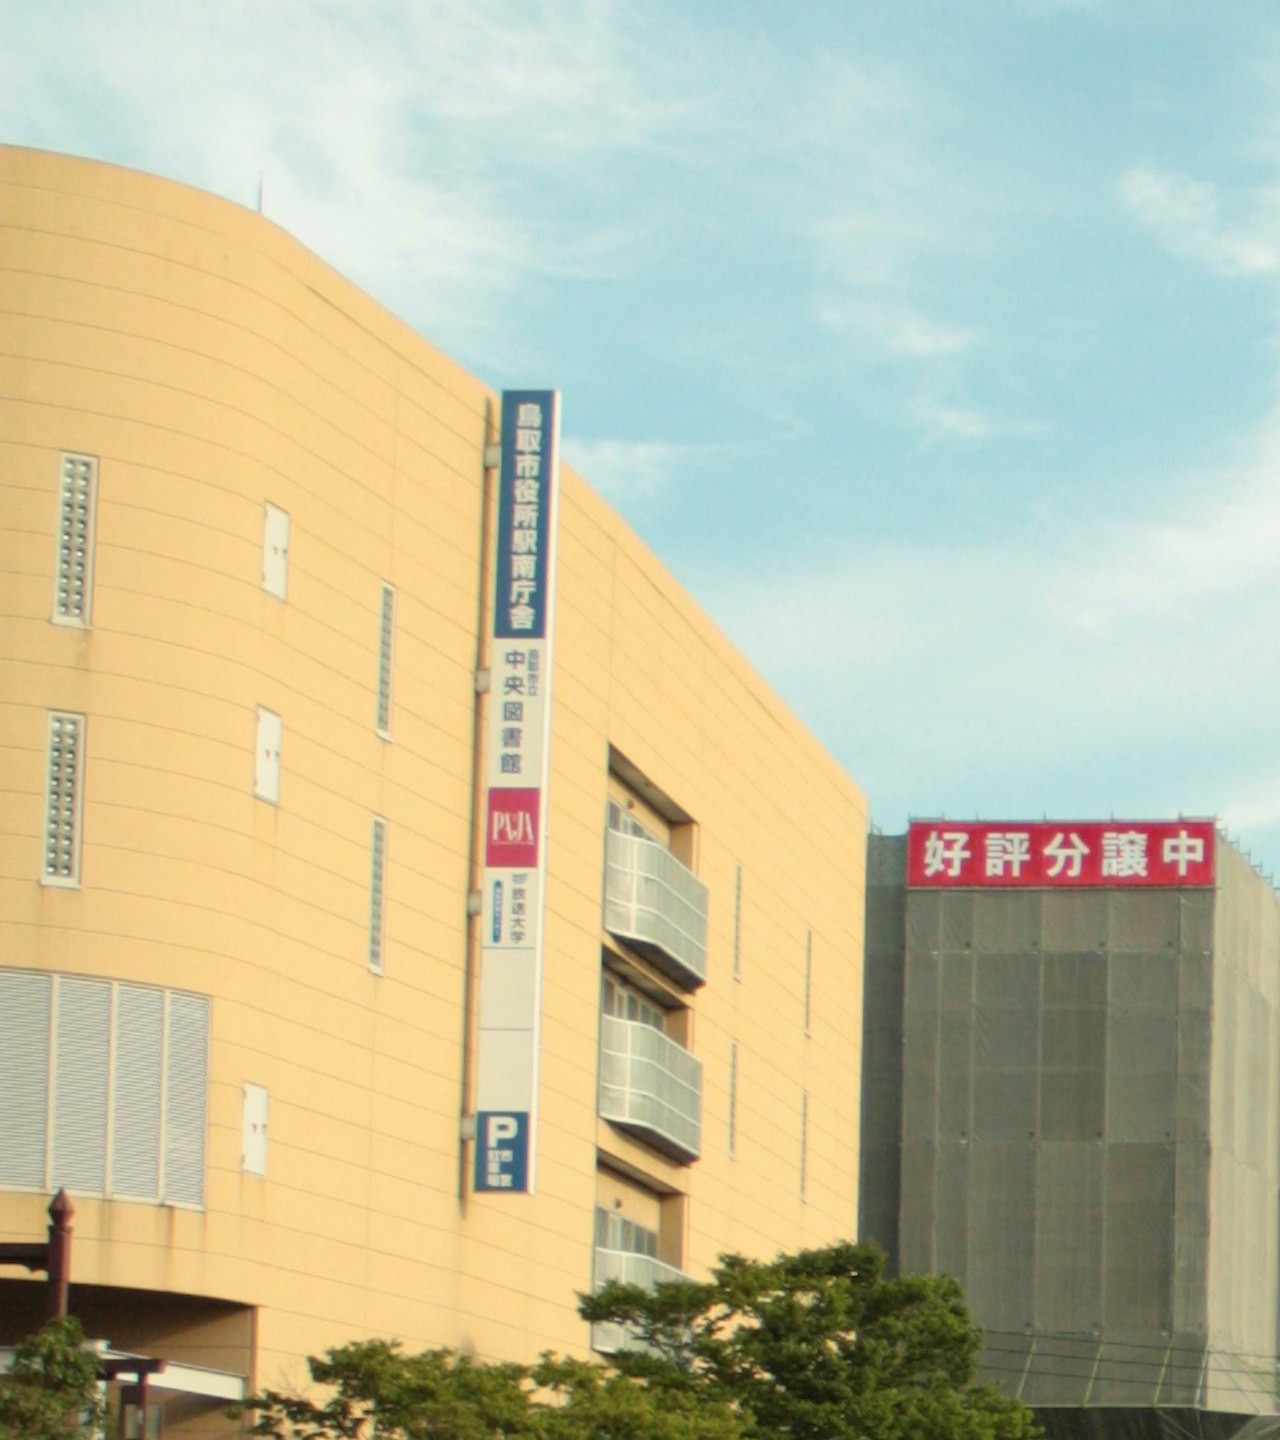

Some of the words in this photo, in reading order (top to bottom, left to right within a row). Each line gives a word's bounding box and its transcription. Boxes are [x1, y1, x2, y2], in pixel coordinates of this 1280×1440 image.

[510, 403, 542, 630] 鳥取市役所駅南庁舎
[501, 649, 525, 773] 中央図書館
[924, 830, 1205, 878] 好評分譲中
[487, 1116, 519, 1149] P
